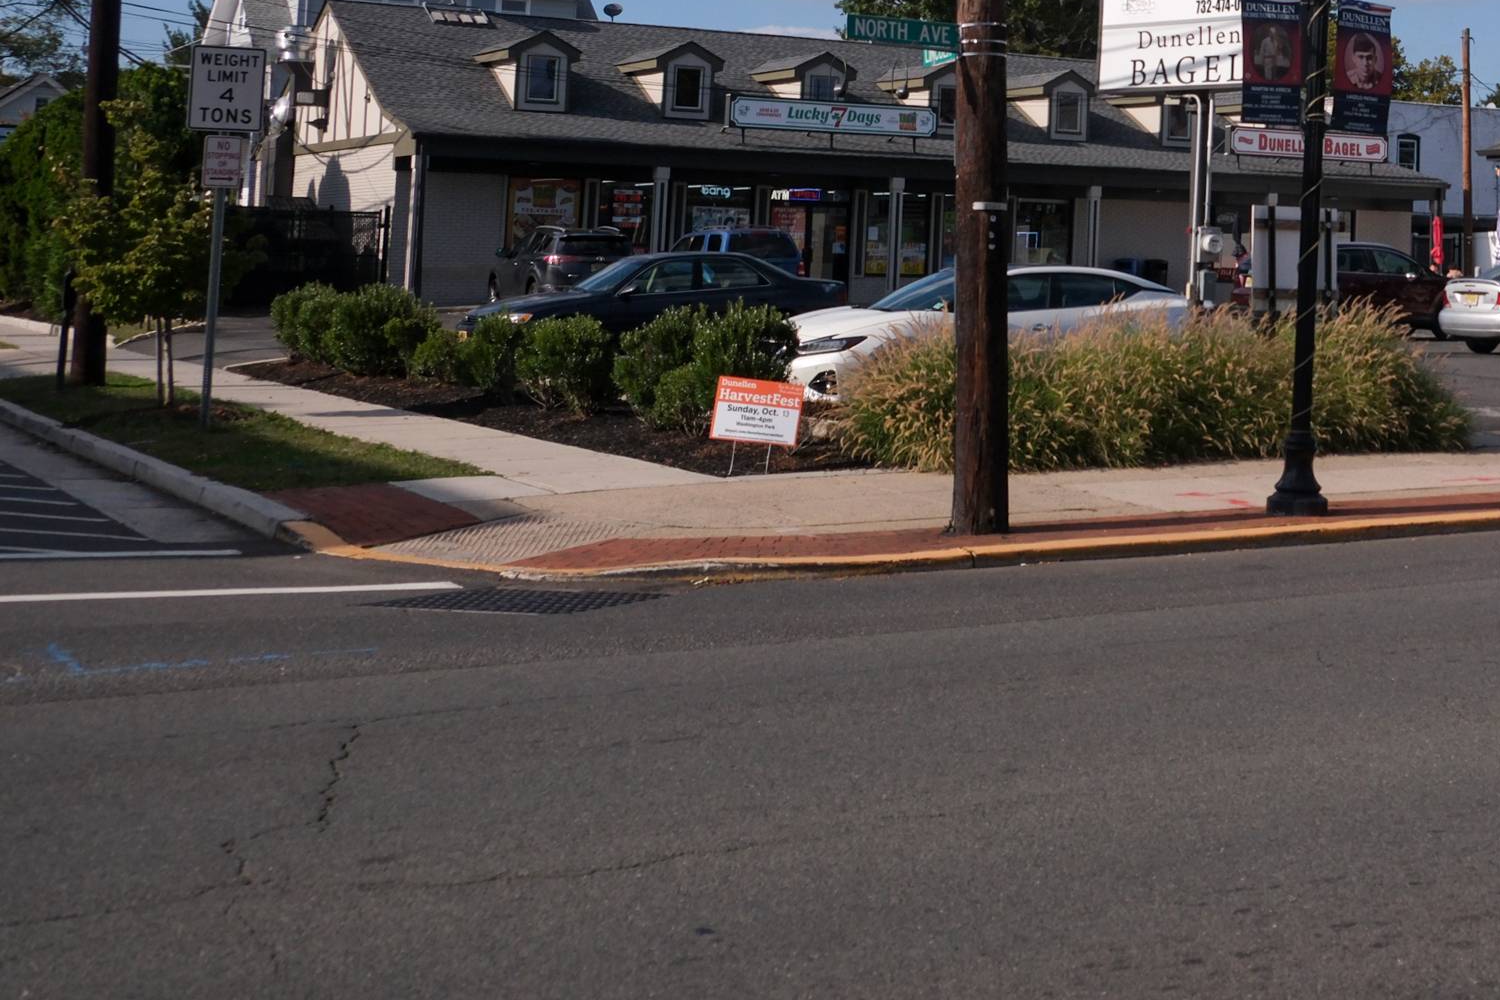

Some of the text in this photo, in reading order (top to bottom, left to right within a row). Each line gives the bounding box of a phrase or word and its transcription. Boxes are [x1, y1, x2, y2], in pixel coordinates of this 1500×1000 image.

[1246, 2, 1296, 14] DUNELLEN
[1342, 11, 1386, 27] DUNELLEN
[855, 18, 951, 44] NORTH AVE
[1137, 26, 1241, 49] Dunellen
[201, 52, 260, 68] WEIGHT
[207, 69, 249, 84] LIMIT
[1129, 54, 1243, 86] BAGEL
[219, 87, 234, 103] 4
[200, 107, 252, 124] TONS
[787, 106, 830, 124] Lucky
[831, 107, 848, 128] 7
[847, 110, 881, 127] Days
[217, 141, 231, 151] NO
[1258, 133, 1362, 157] DUNELL BAGEL
[701, 185, 731, 198] bang
[771, 190, 790, 200] ATM
[722, 379, 757, 389] Dunellen
[719, 388, 800, 408] HarvestFest
[728, 404, 760, 415] Sunday,
[762, 407, 779, 416] Oct.
